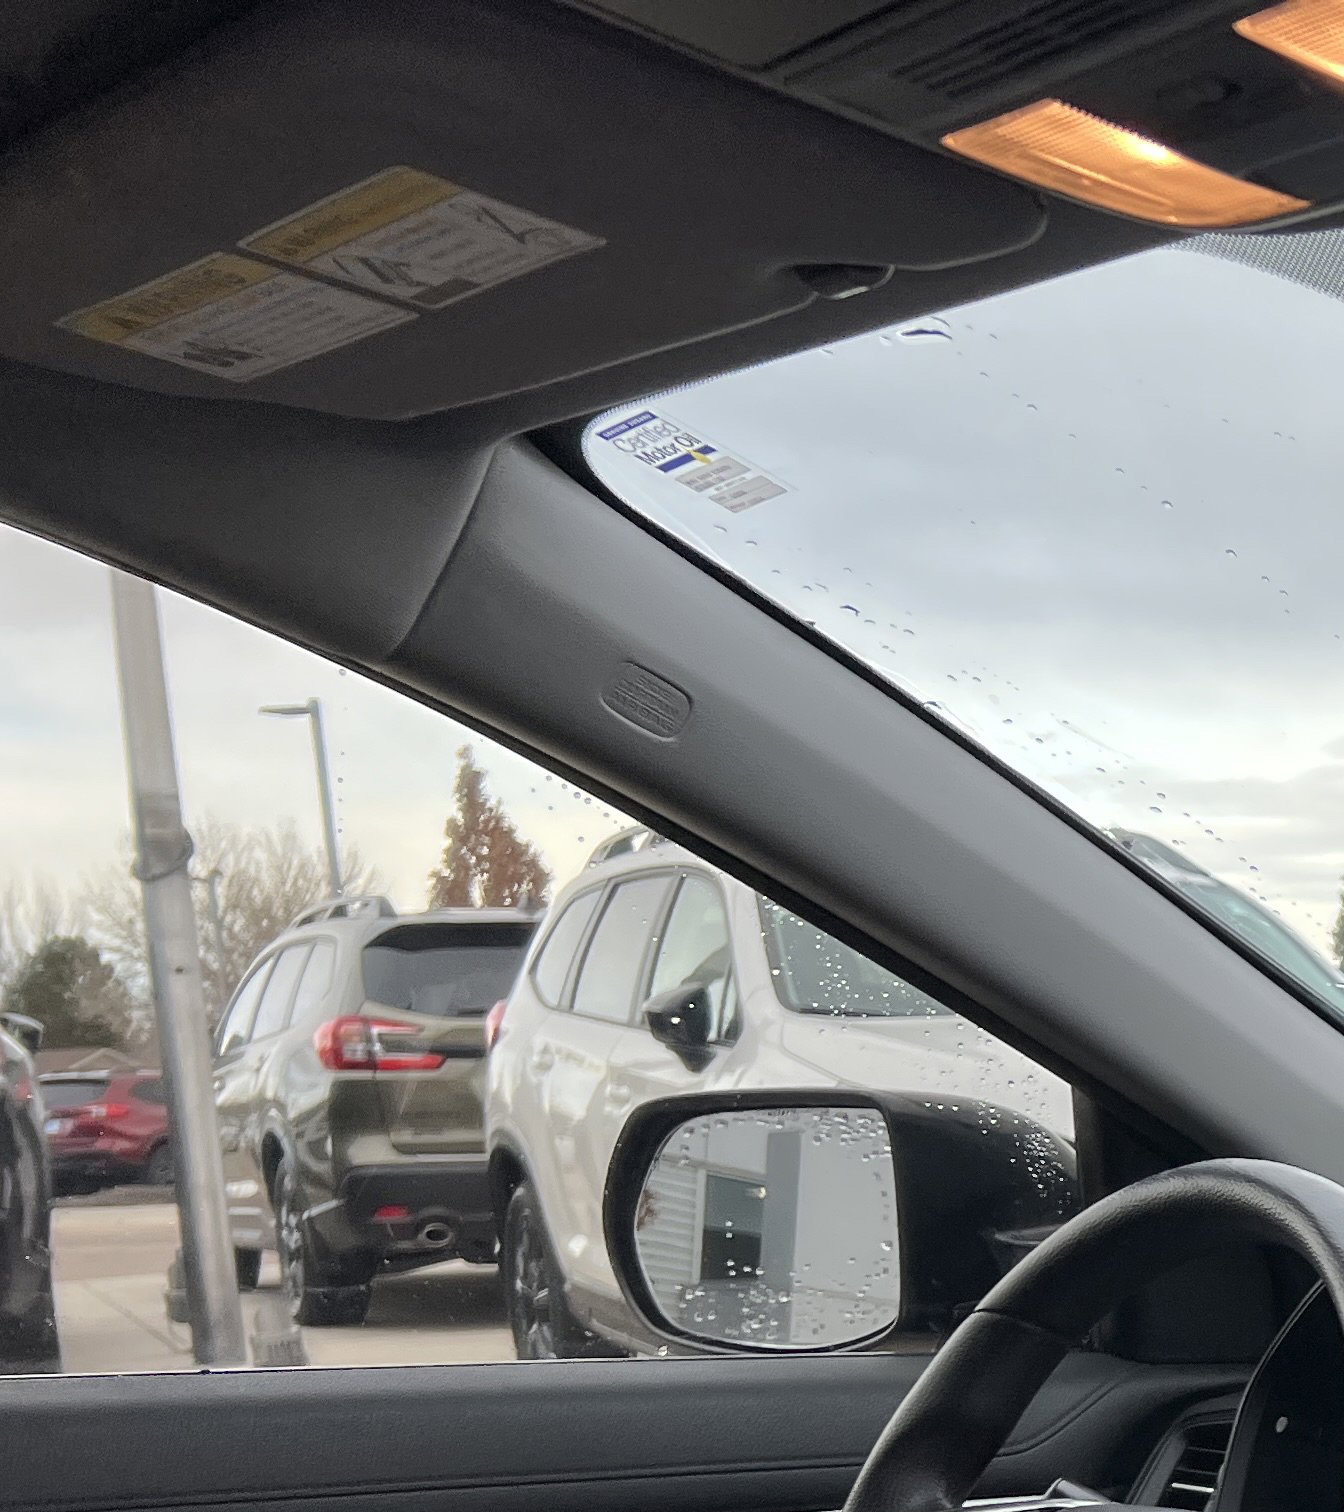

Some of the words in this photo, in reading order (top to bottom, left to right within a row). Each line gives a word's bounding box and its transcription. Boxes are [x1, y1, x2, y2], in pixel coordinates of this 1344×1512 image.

[613, 421, 680, 453] Certified
[634, 443, 681, 465] Motor
[674, 432, 702, 448] Oil
